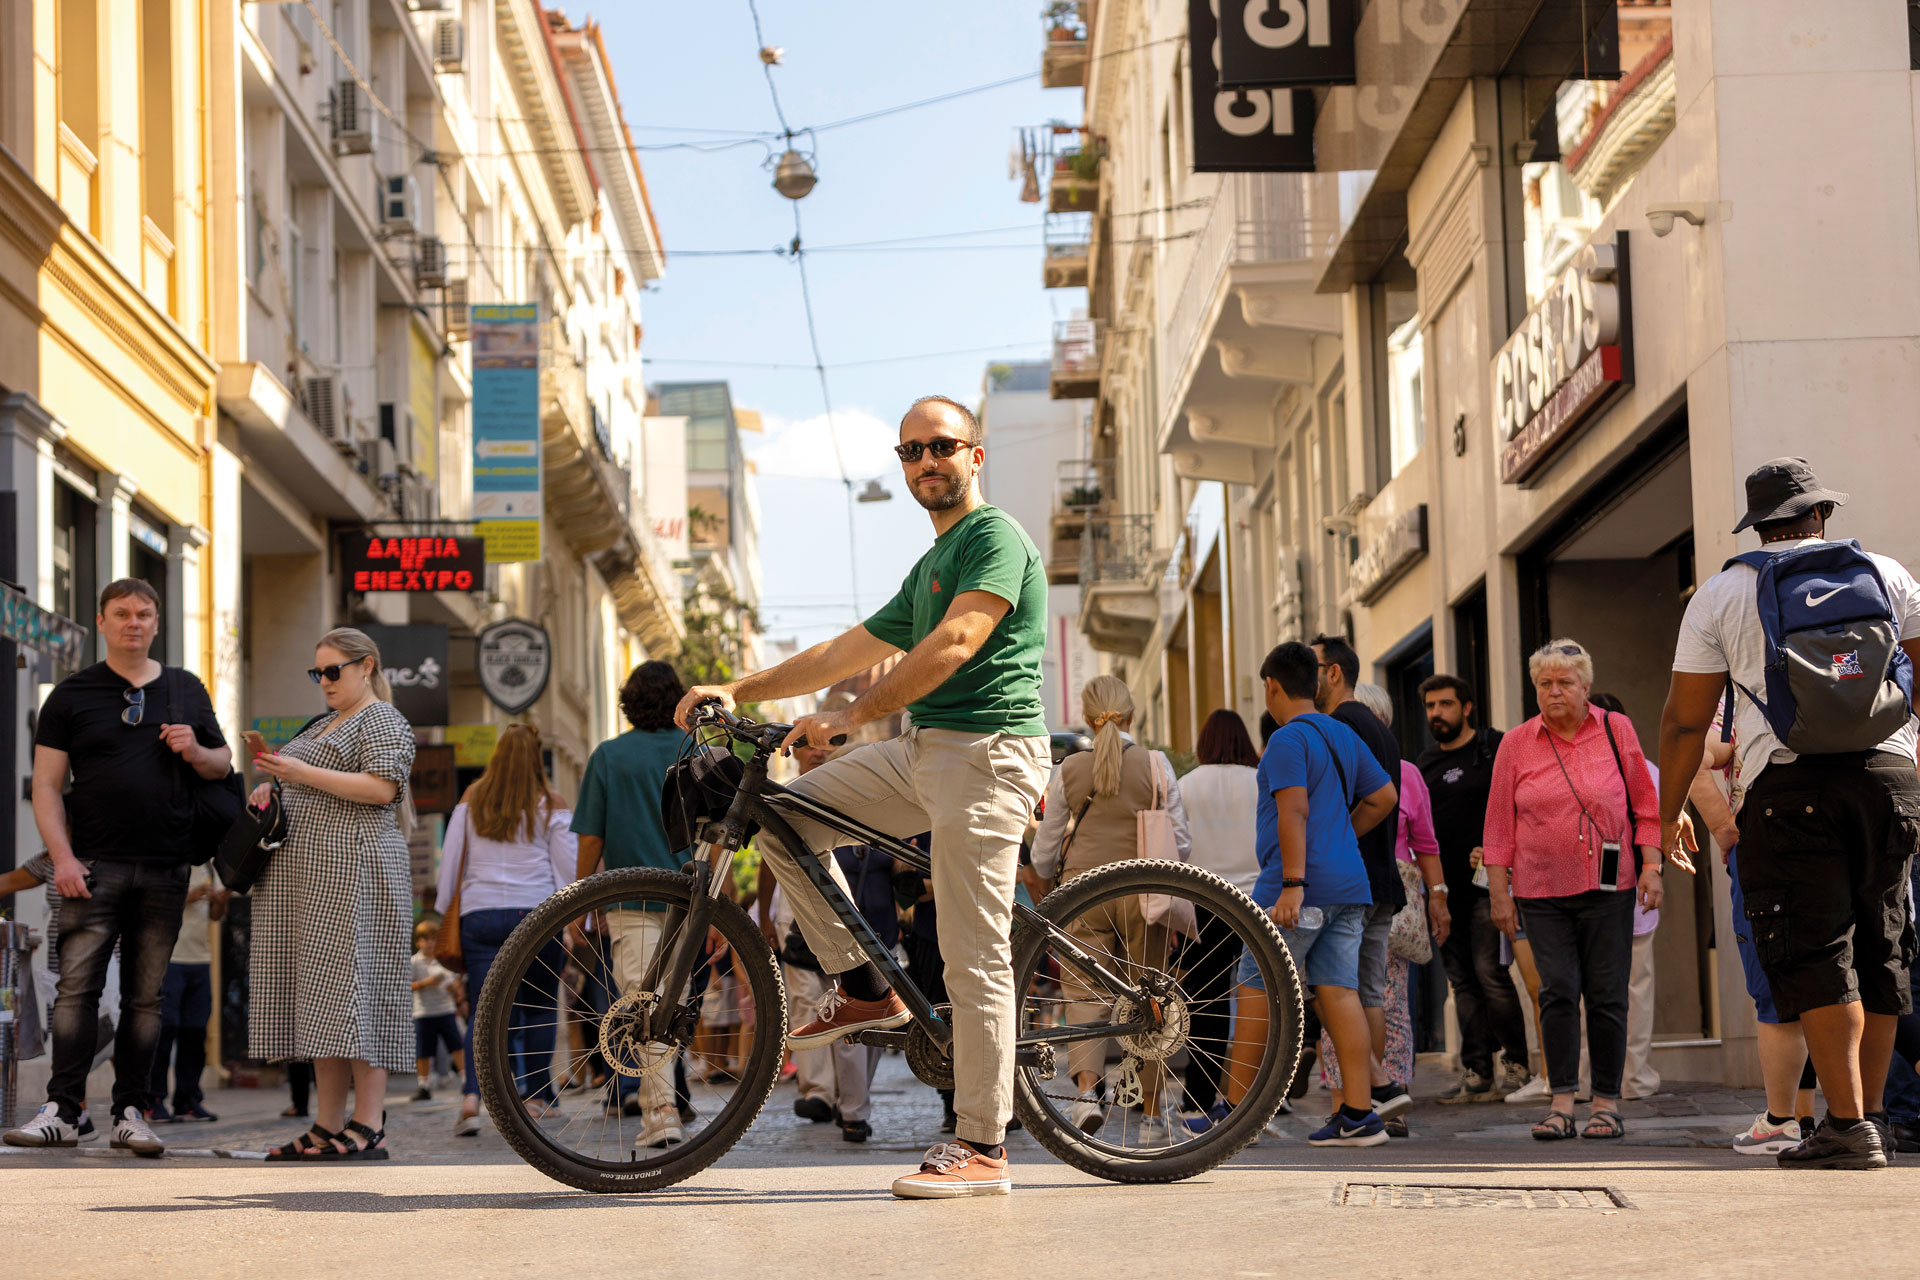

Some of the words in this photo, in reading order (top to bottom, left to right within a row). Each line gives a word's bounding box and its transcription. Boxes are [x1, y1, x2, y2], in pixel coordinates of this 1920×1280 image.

[366, 538, 460, 558] ΔΑΝΕΙΑ
[354, 570, 473, 591] ΕΝΕΧΥΡΟ
[1838, 664, 1863, 675] USA
